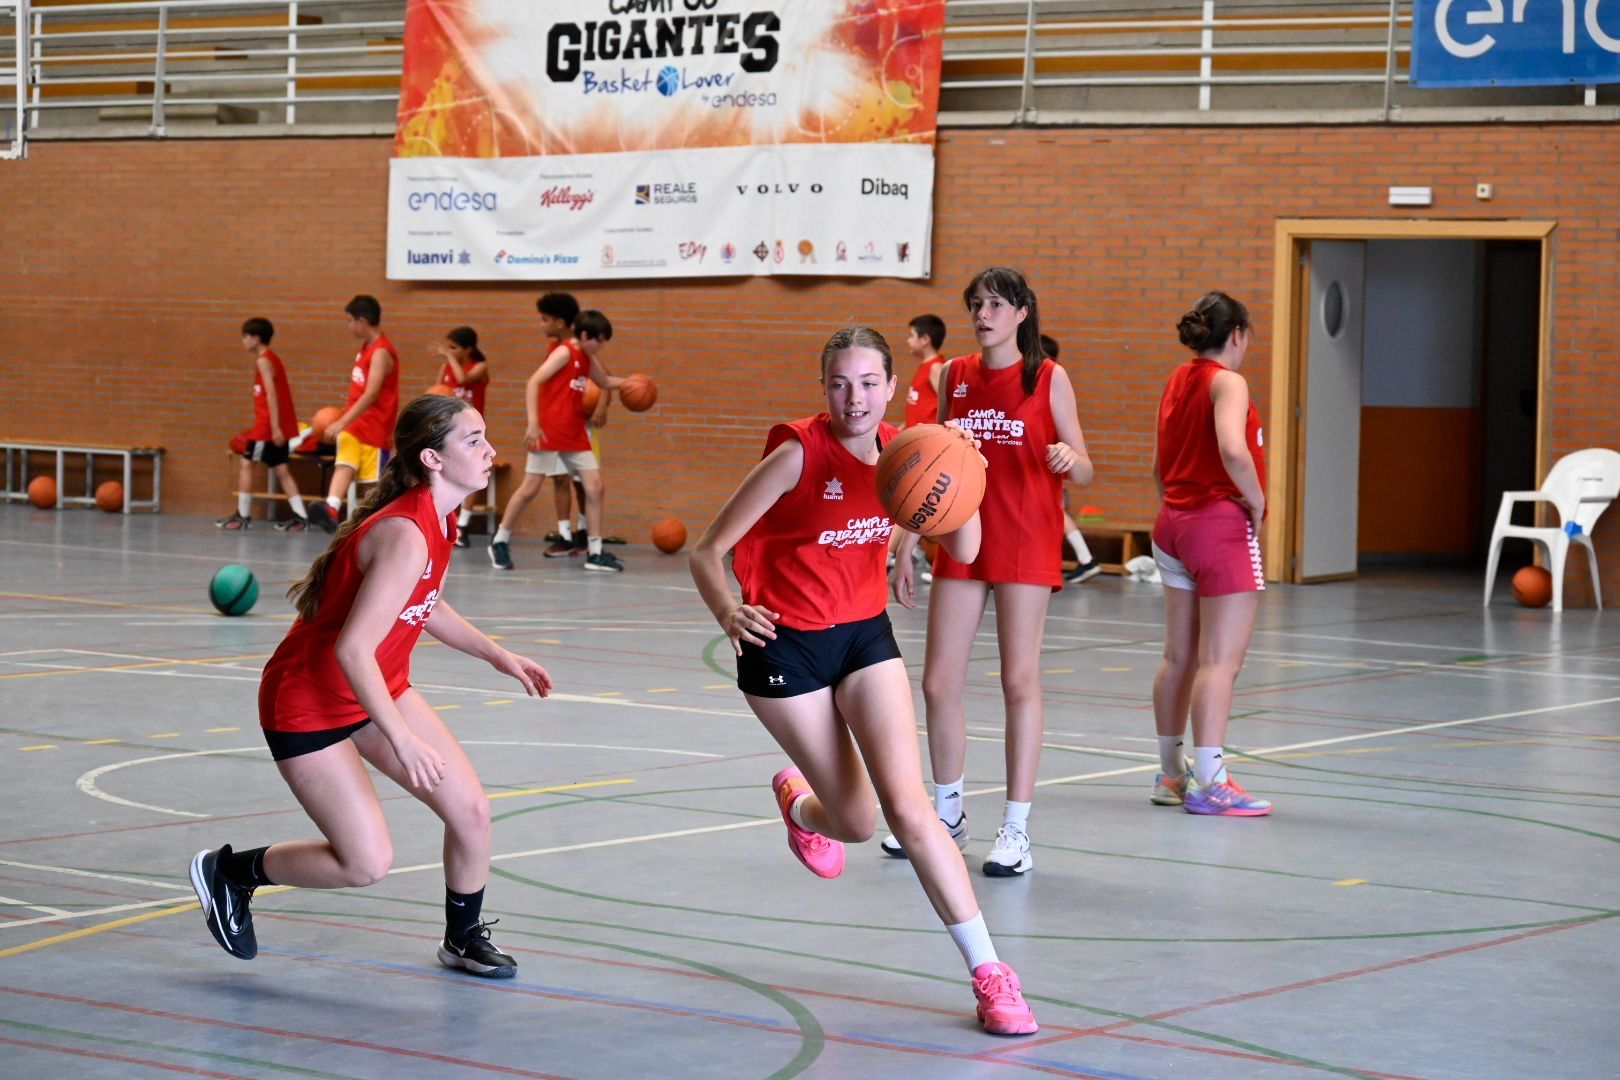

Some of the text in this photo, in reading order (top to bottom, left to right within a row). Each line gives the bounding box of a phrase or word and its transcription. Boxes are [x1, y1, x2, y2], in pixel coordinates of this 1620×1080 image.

[546, 11, 781, 82] GIGANTES
[583, 67, 735, 94] Basket Lover
[711, 91, 777, 108] endesa
[653, 182, 697, 194] REALE
[736, 183, 823, 195] VOLVO
[860, 178, 908, 200] Dibaq
[408, 187, 497, 211] endesa
[540, 185, 594, 211] Kellogg's
[653, 194, 698, 204] SEGUROS
[407, 248, 454, 264] luanvi
[507, 253, 579, 264] Domino's Pizza
[967, 408, 1006, 419] CAMPUS
[906, 472, 952, 530] molten
[817, 525, 895, 545] GIGANTE
